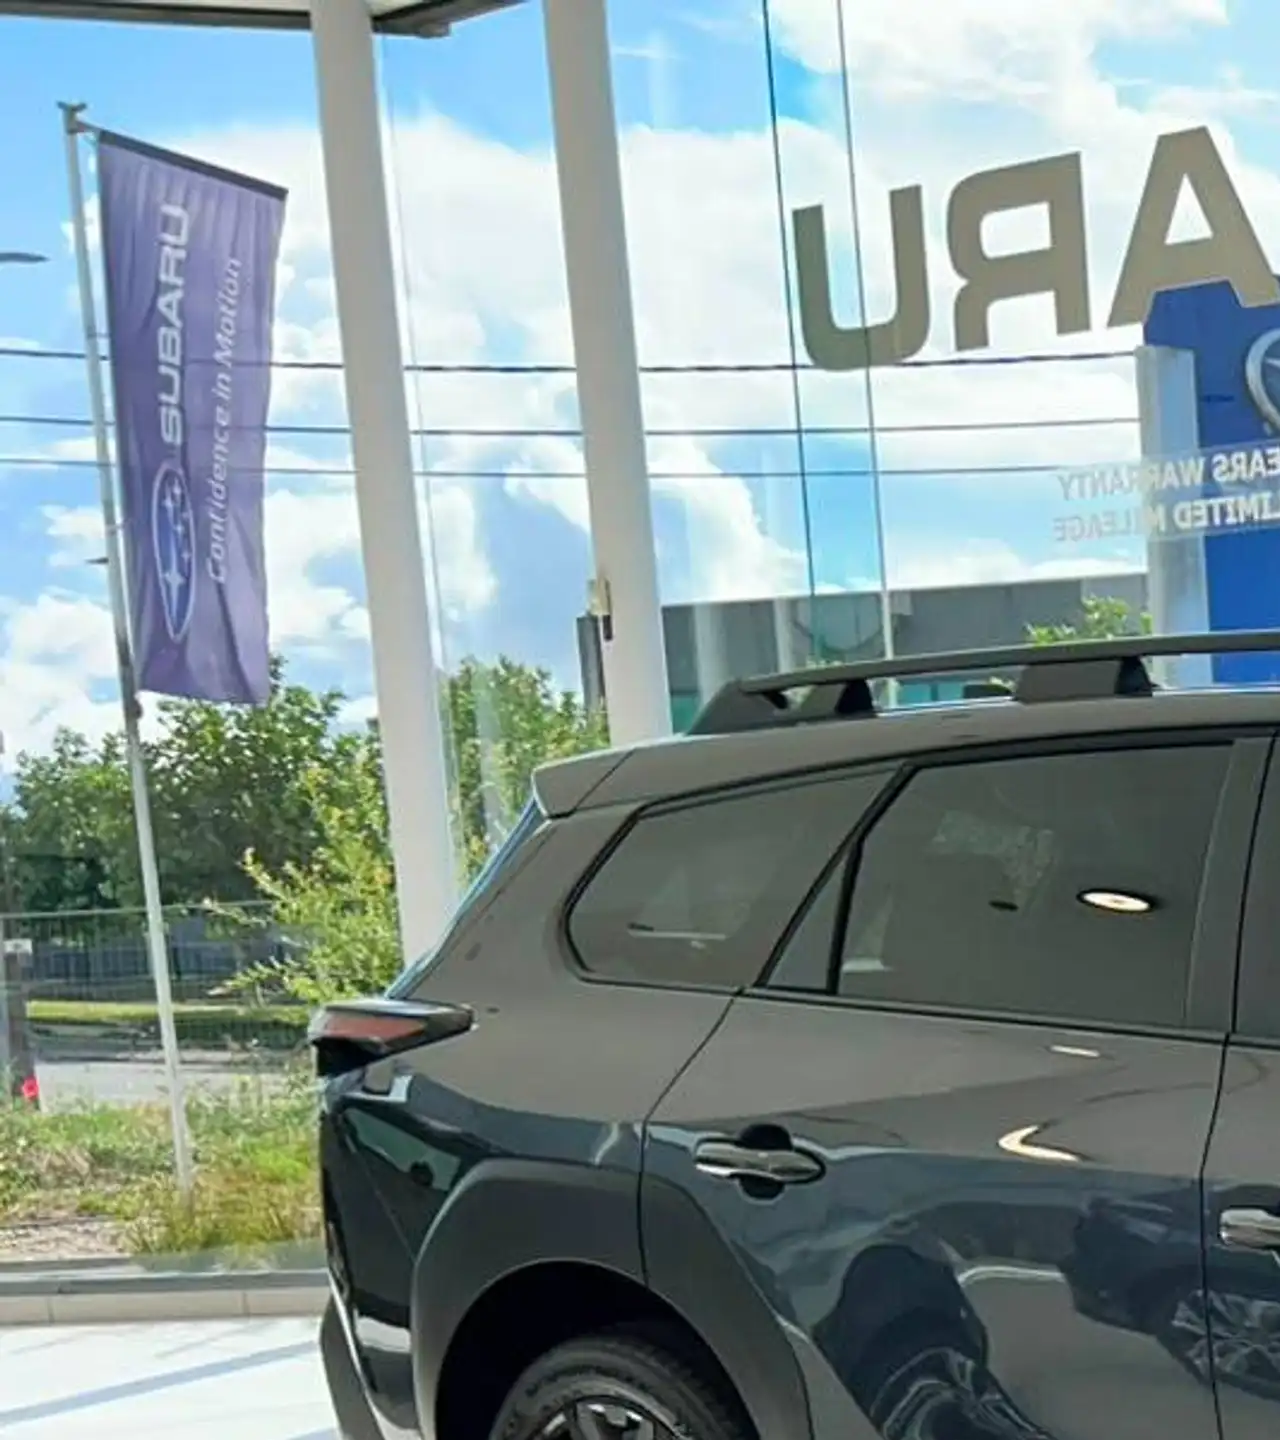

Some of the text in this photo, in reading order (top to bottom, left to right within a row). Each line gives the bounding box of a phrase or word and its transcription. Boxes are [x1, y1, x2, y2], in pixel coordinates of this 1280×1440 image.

[157, 203, 189, 446] SUBARU
[206, 259, 242, 584] Confidence in Motion
